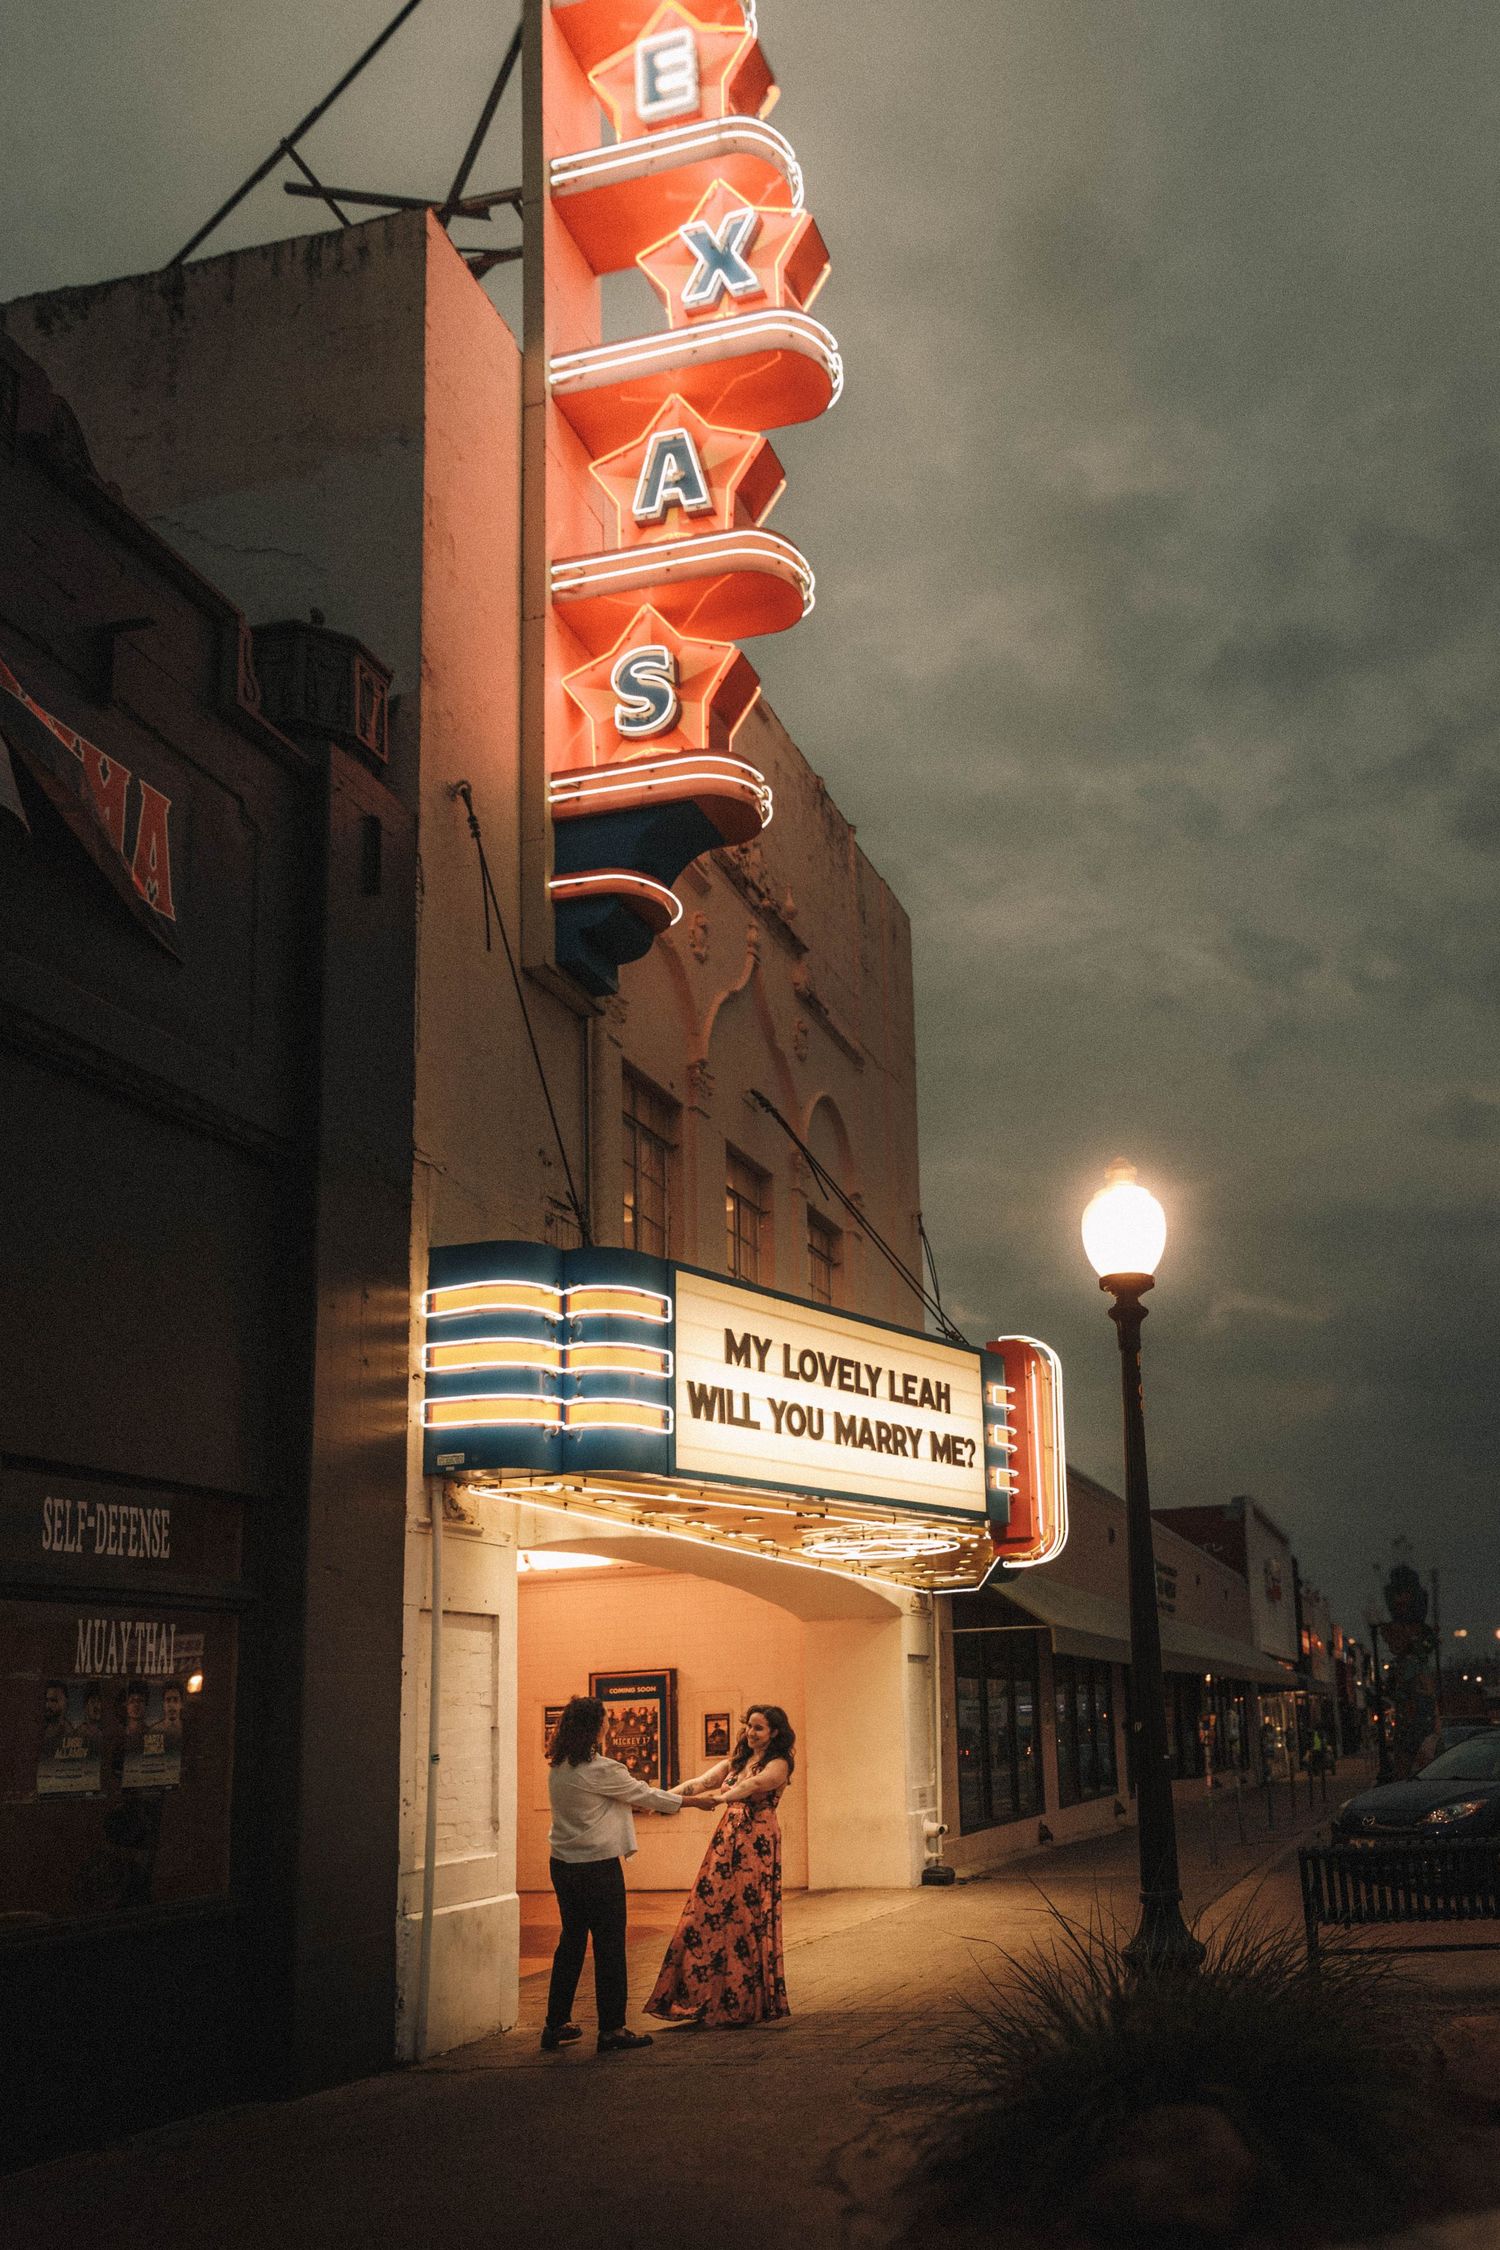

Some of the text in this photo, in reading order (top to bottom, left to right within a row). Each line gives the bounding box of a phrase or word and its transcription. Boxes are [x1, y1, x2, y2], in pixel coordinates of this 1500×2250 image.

[724, 1328, 950, 1414] MY LOVELY LEAH
[686, 1380, 976, 1468] WILL YOU MARRY ME?
[42, 1496, 170, 1558] SELF-DEFENSE
[75, 1619, 176, 1673] MUAY THAI
[613, 1736, 651, 1745] MICKEY 17
